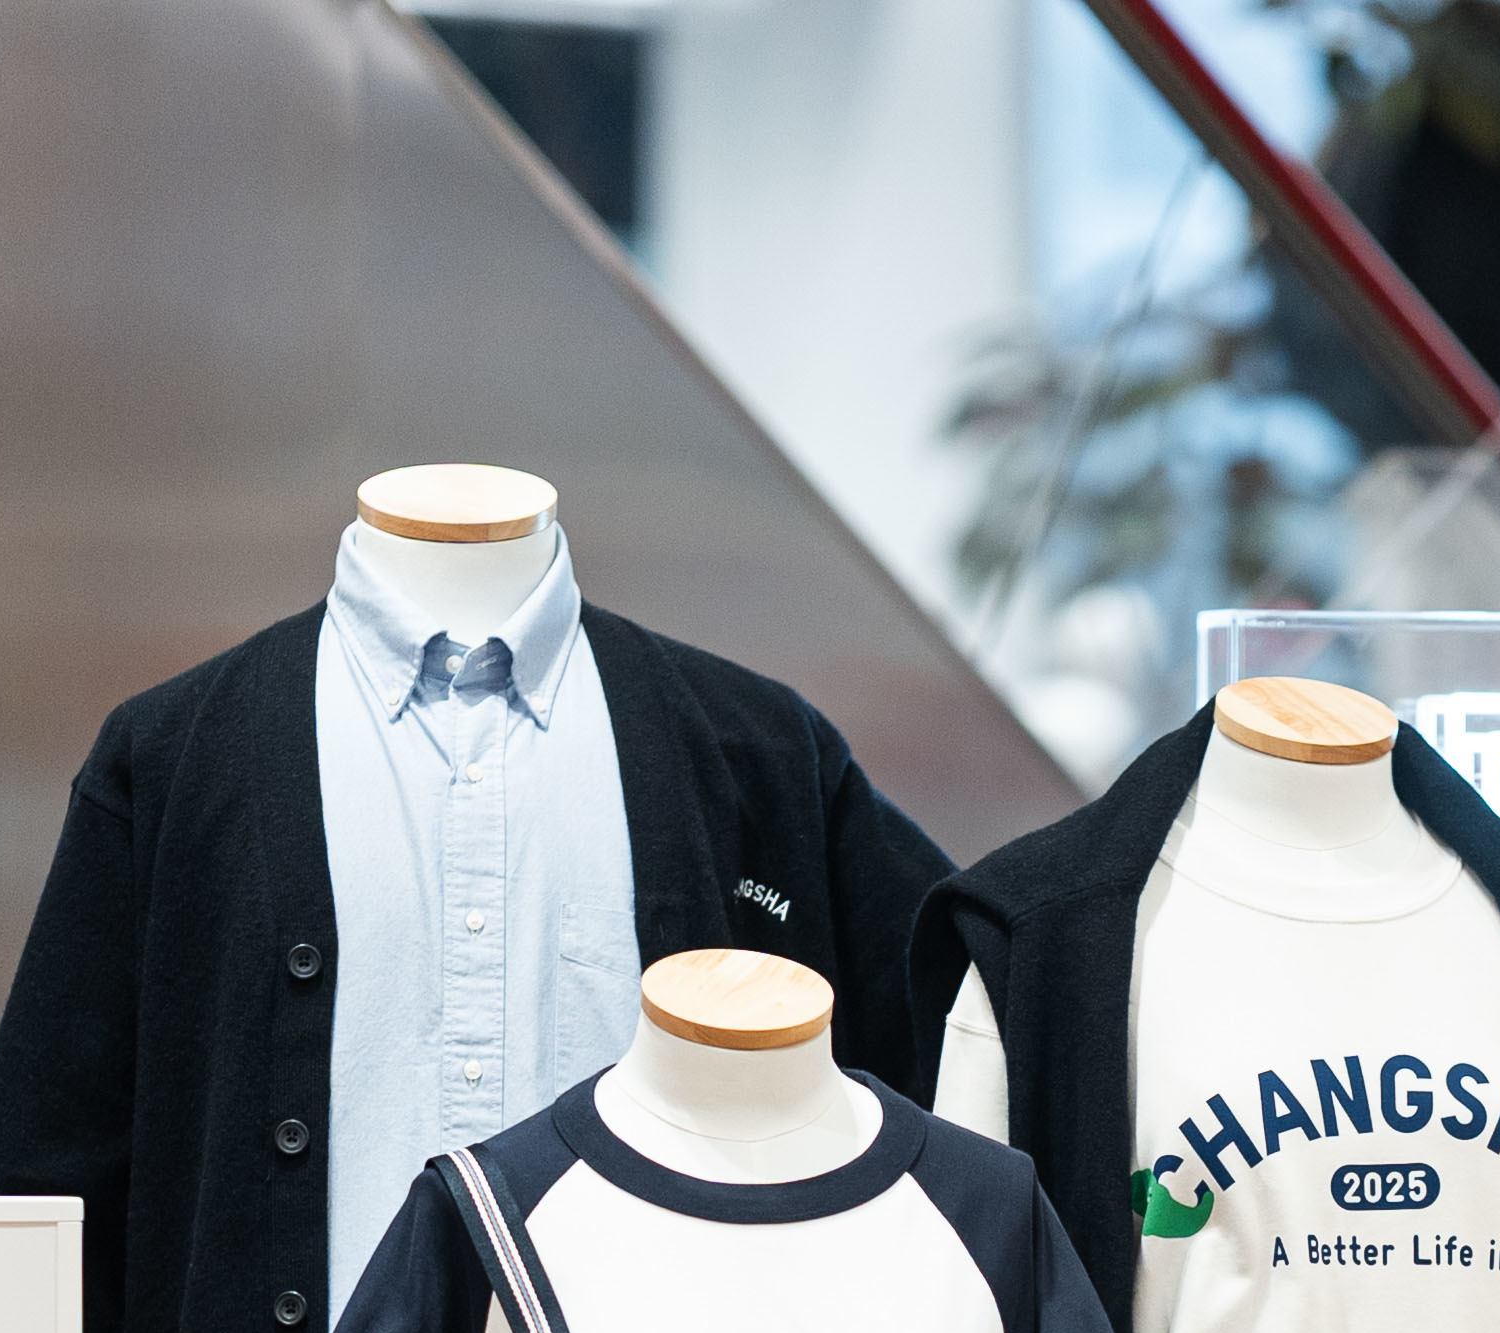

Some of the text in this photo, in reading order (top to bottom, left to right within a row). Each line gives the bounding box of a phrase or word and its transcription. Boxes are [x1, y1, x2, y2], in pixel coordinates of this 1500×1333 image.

[1342, 1169, 1429, 1205] 2025
[1272, 1236, 1290, 1268] A
[1307, 1233, 1396, 1266] Better
[1413, 1233, 1474, 1268] Life
